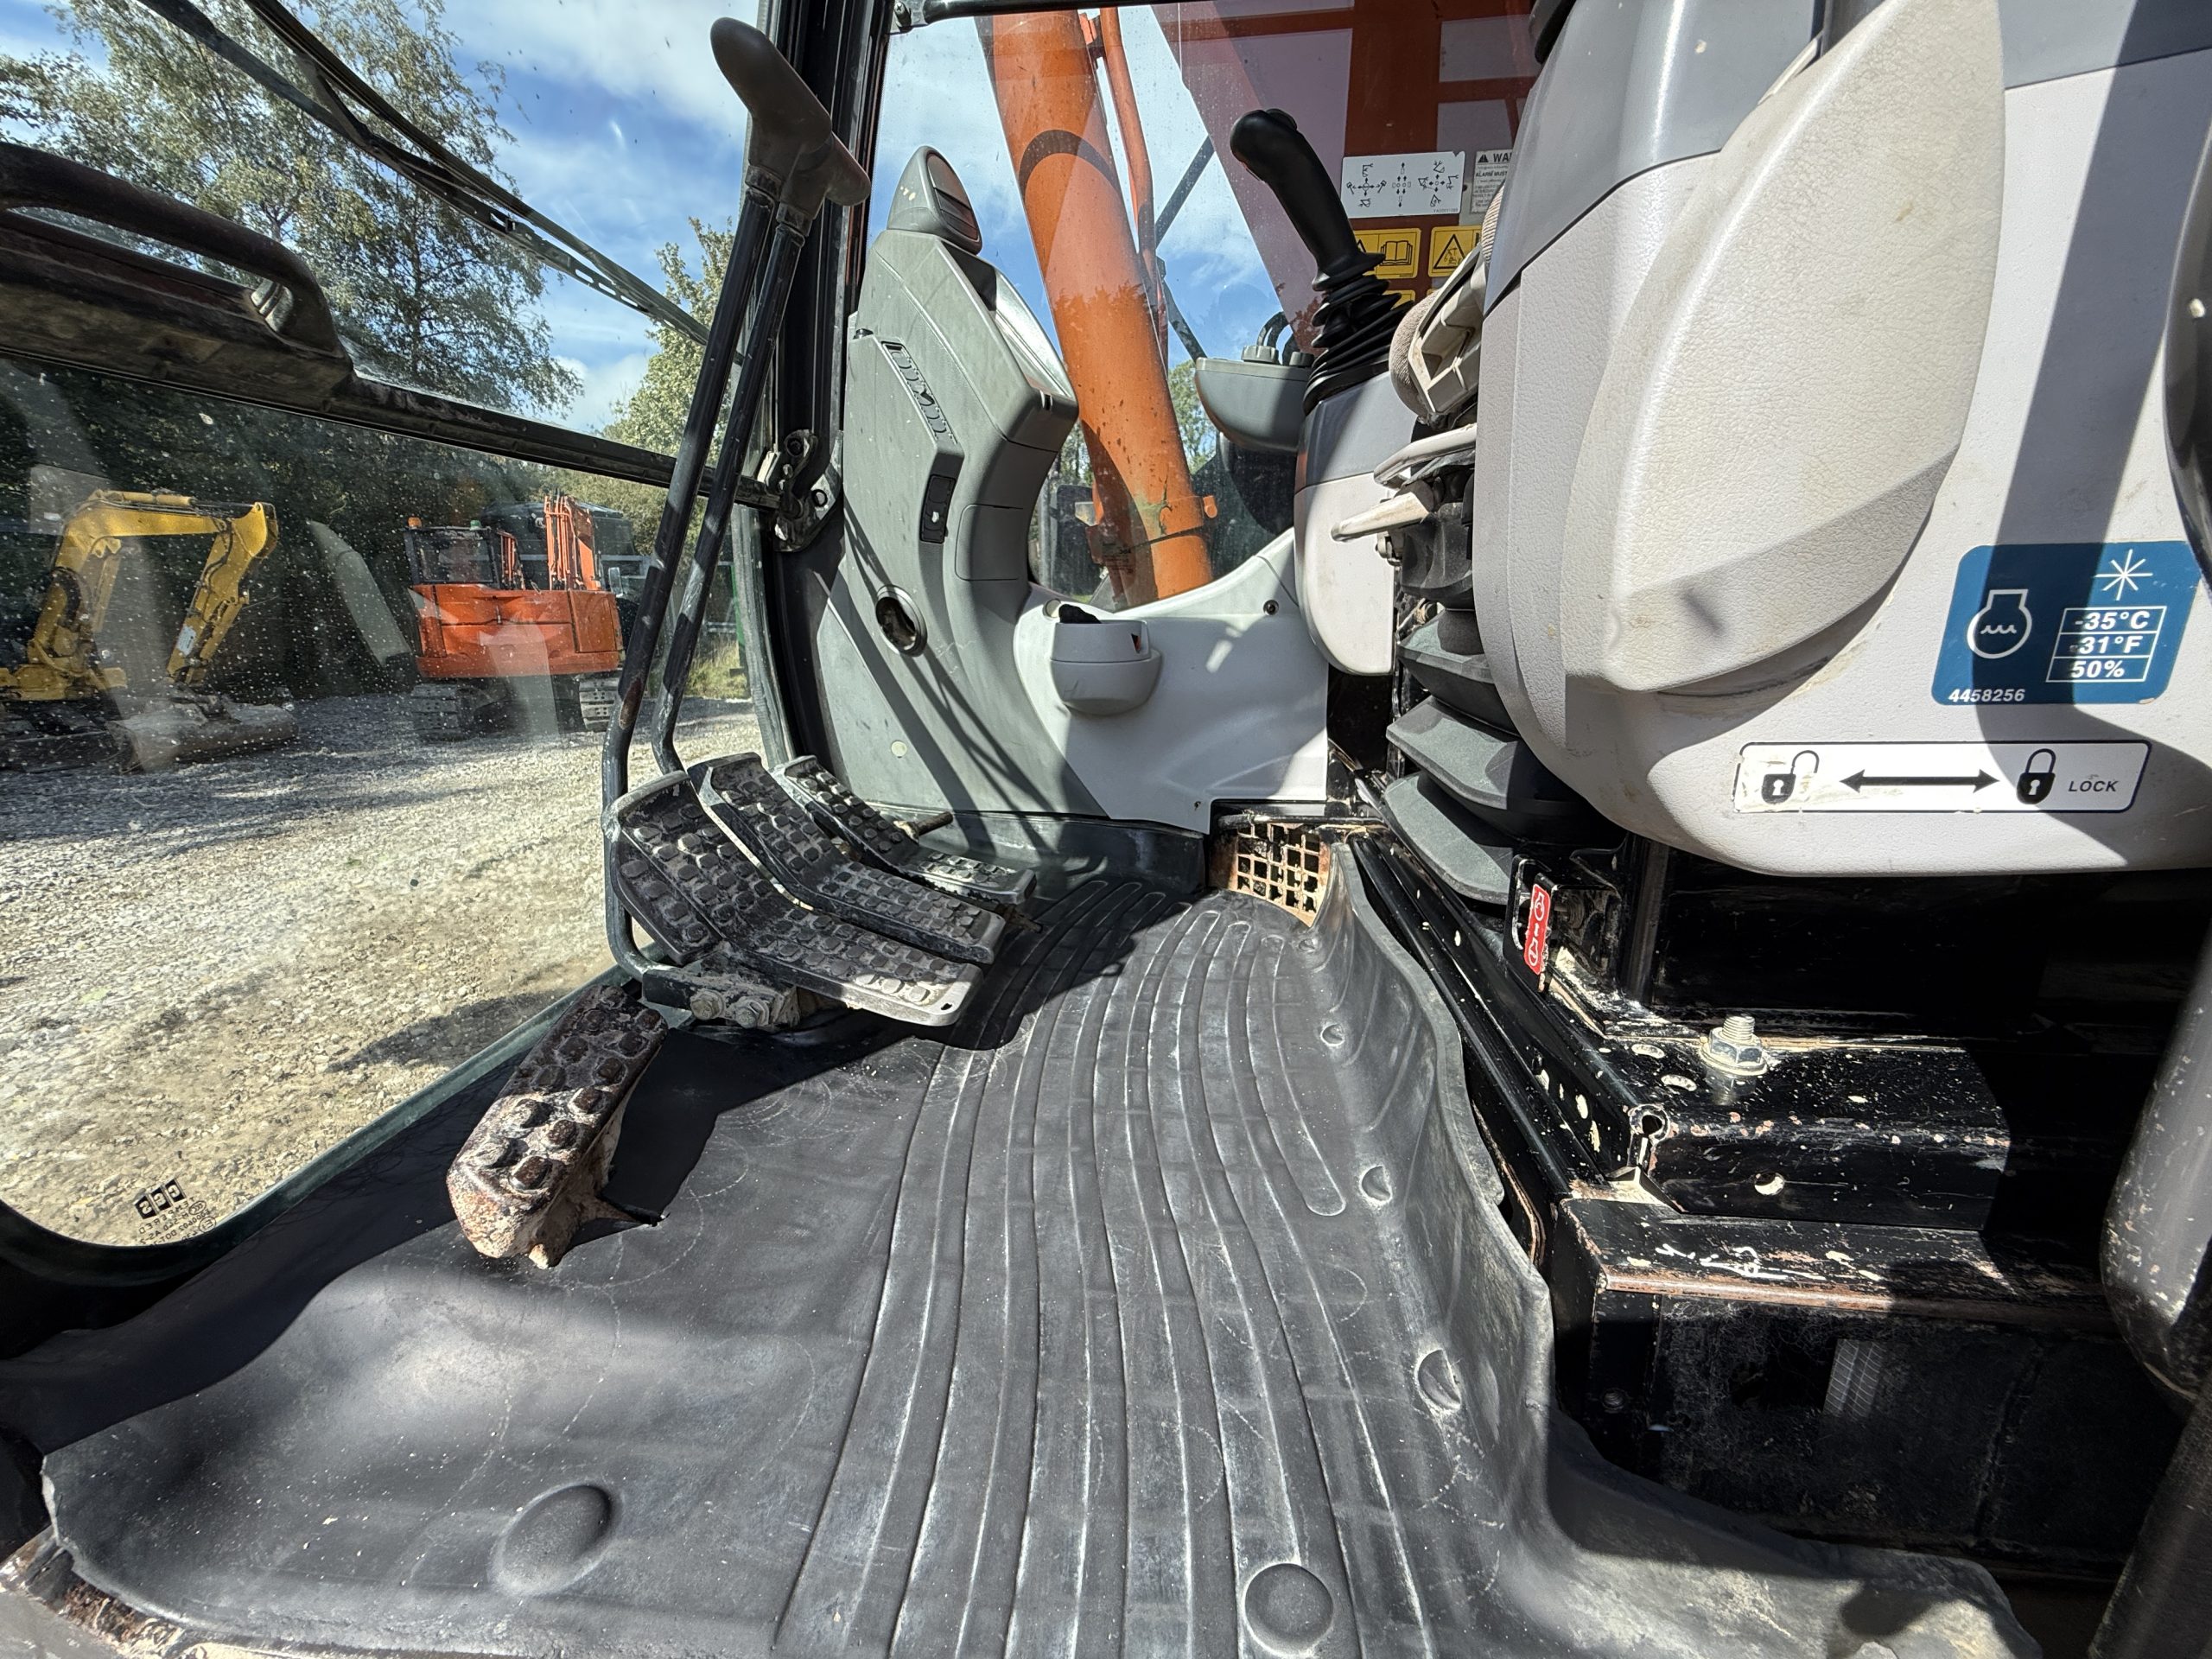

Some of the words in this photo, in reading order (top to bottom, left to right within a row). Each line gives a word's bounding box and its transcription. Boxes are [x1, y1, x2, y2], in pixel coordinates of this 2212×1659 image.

[2070, 660, 2125, 678] 50%
[1948, 688, 2026, 702] 4458256
[2067, 779, 2118, 793] LOCK
